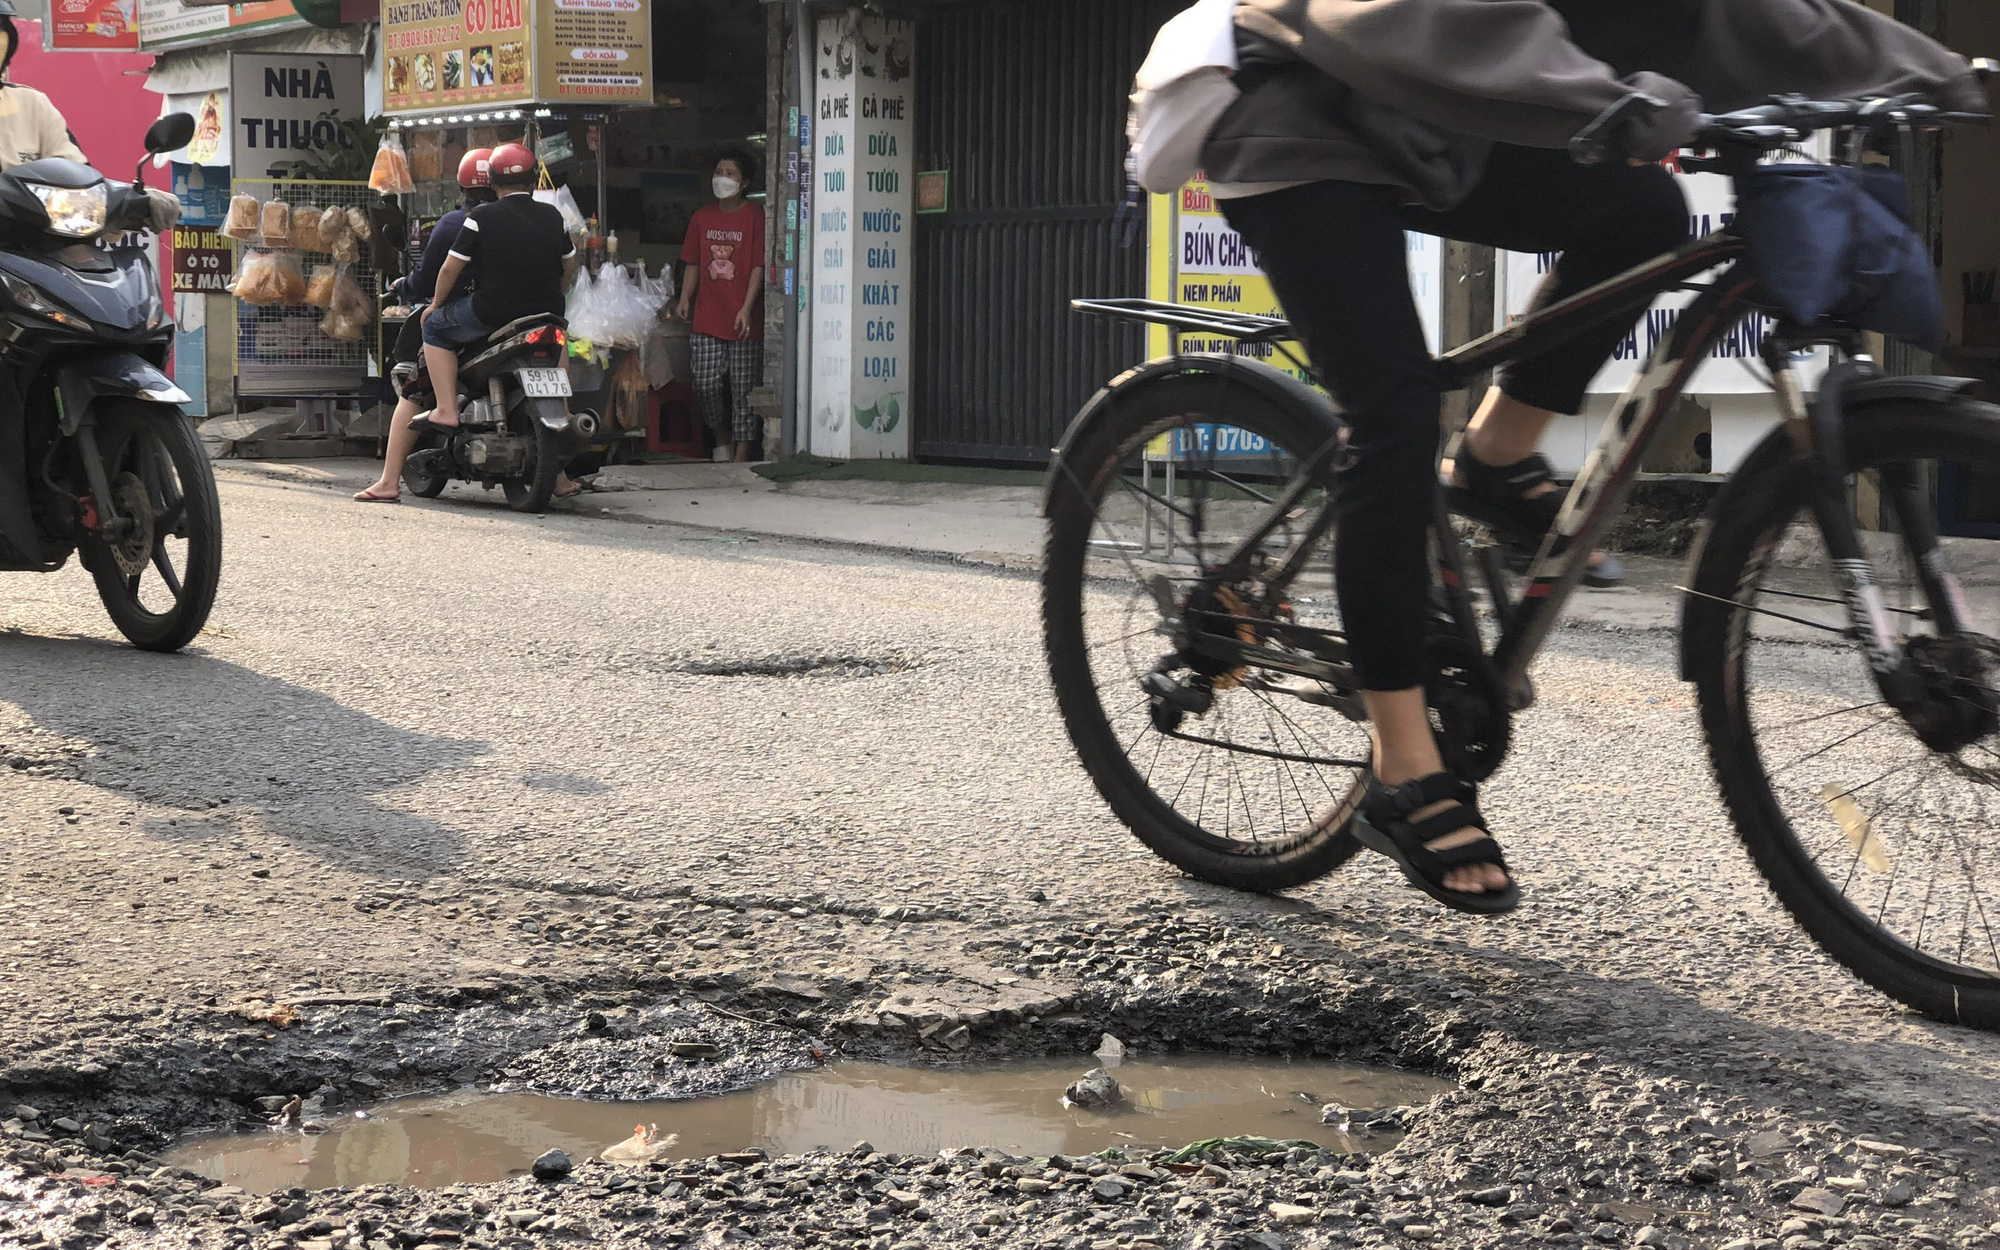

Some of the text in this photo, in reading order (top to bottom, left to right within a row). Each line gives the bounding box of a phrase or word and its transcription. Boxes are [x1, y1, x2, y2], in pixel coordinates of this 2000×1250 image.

[264, 61, 336, 99] NHÀ
[821, 94, 849, 120] CÀ PHÊ
[862, 93, 904, 120] CÀ PHÊ
[825, 131, 844, 156] DỪA
[868, 130, 897, 156] DỪA
[862, 207, 901, 233] NƯỚC
[174, 226, 198, 249] BẢO
[706, 230, 743, 242] MOSCHINO
[1184, 222, 1214, 266] BÚN
[187, 254, 219, 268] Ô TÔ
[867, 241, 896, 268] GIẢI
[174, 270, 231, 289] XE MÁY
[862, 280, 900, 305] KHÁT
[1183, 284, 1208, 302] NEM
[866, 316, 895, 341] CÁC
[864, 356, 896, 382] LOẠI
[527, 382, 569, 395] 041.76
